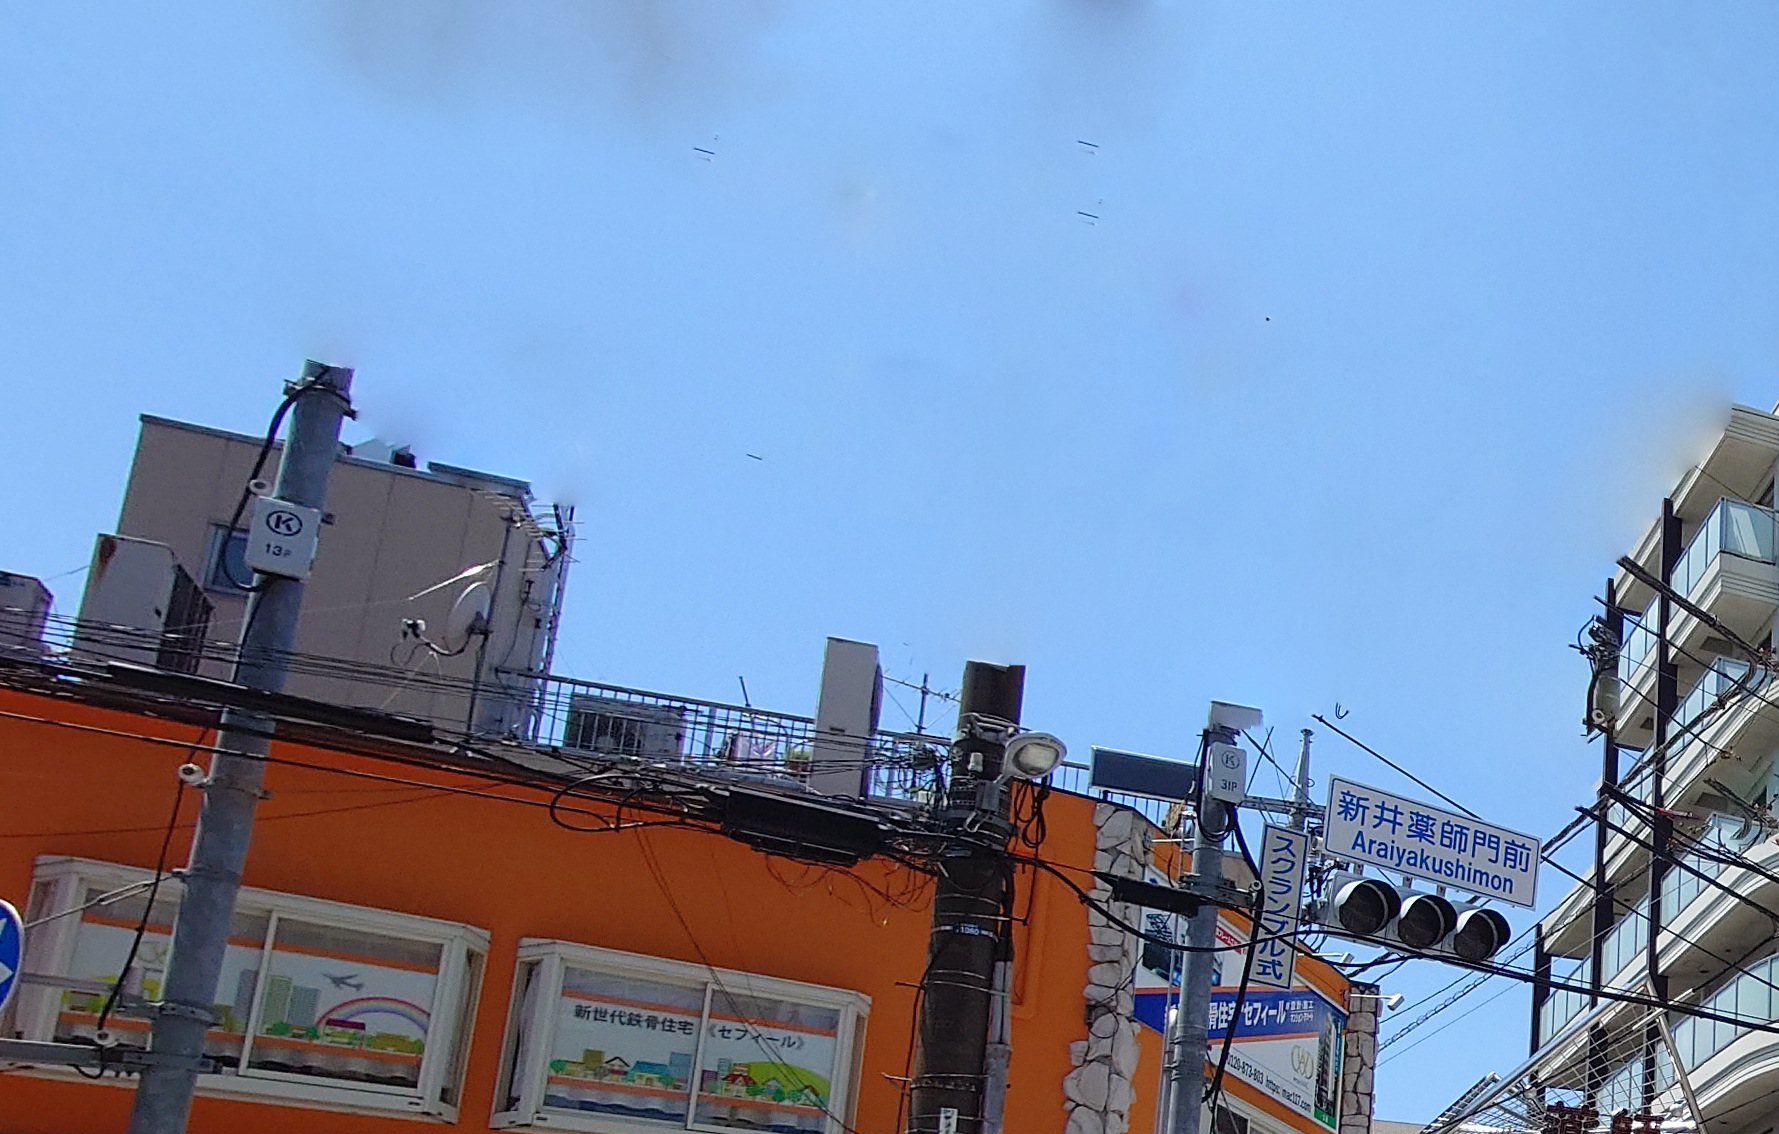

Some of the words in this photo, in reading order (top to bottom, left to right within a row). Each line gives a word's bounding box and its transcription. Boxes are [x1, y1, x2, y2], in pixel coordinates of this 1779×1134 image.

[1337, 790, 1532, 873] 新井薬師門前
[1351, 830, 1514, 895] Araiyakushimon
[1256, 835, 1297, 981] スクランブル式
[574, 1004, 695, 1036] 新世代鉄骨住宅
